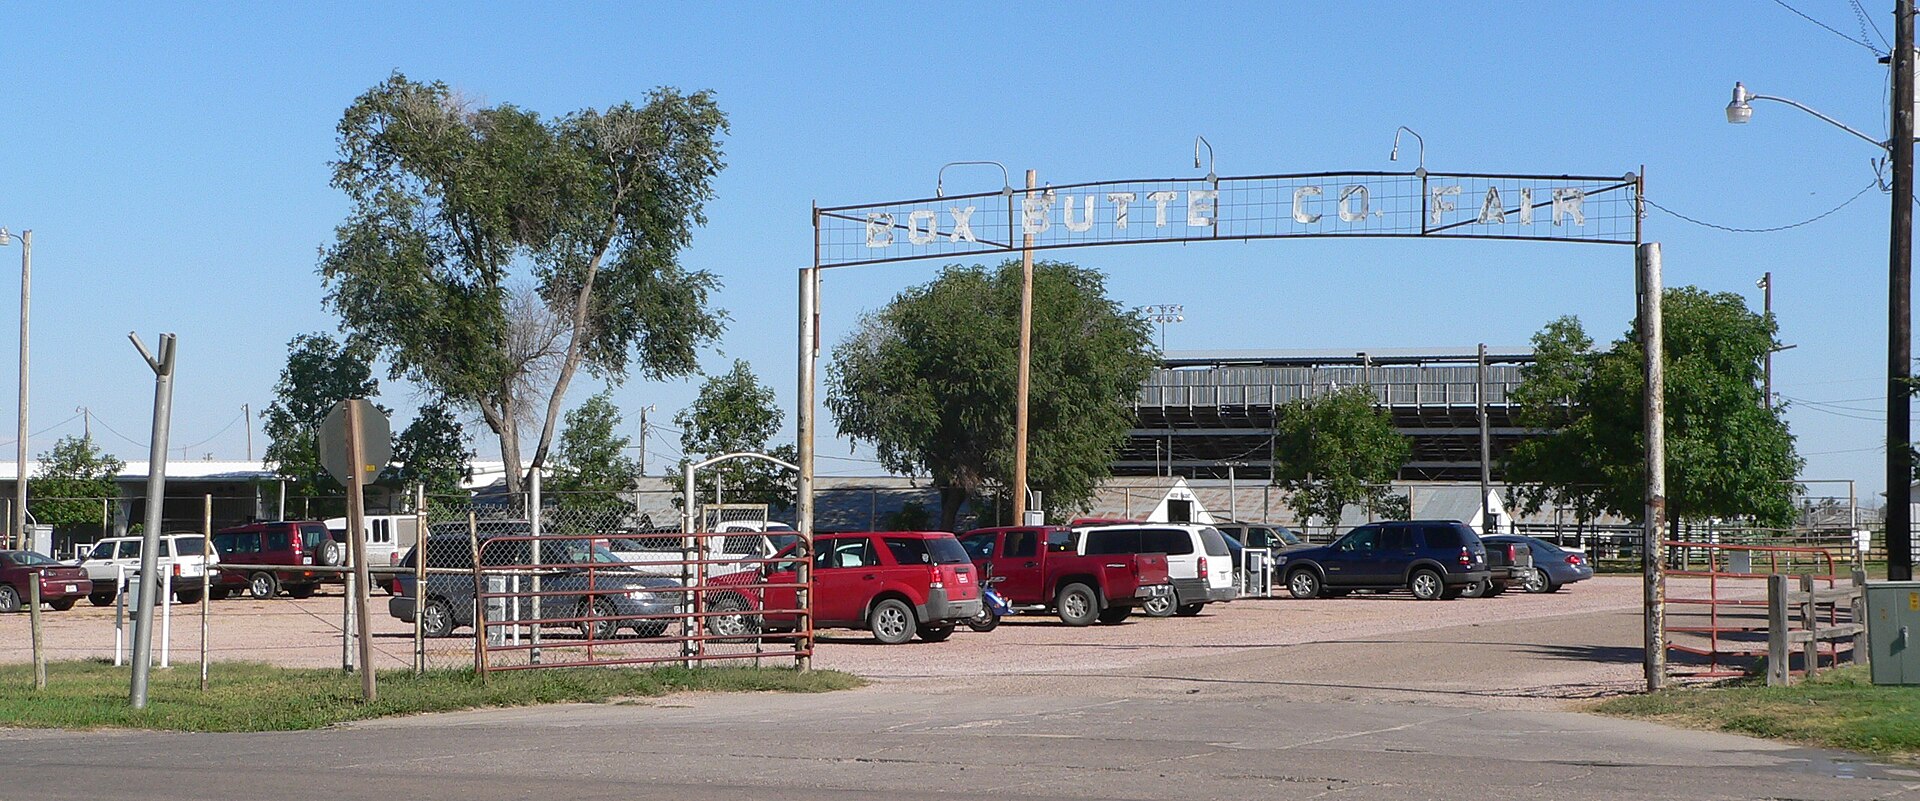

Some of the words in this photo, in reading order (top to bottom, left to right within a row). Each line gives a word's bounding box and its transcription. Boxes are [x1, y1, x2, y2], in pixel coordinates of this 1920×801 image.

[866, 206, 976, 248] BOX
[1022, 190, 1218, 234] BUTTE
[1293, 185, 1383, 224] CO.
[1431, 185, 1584, 226] FAIR
